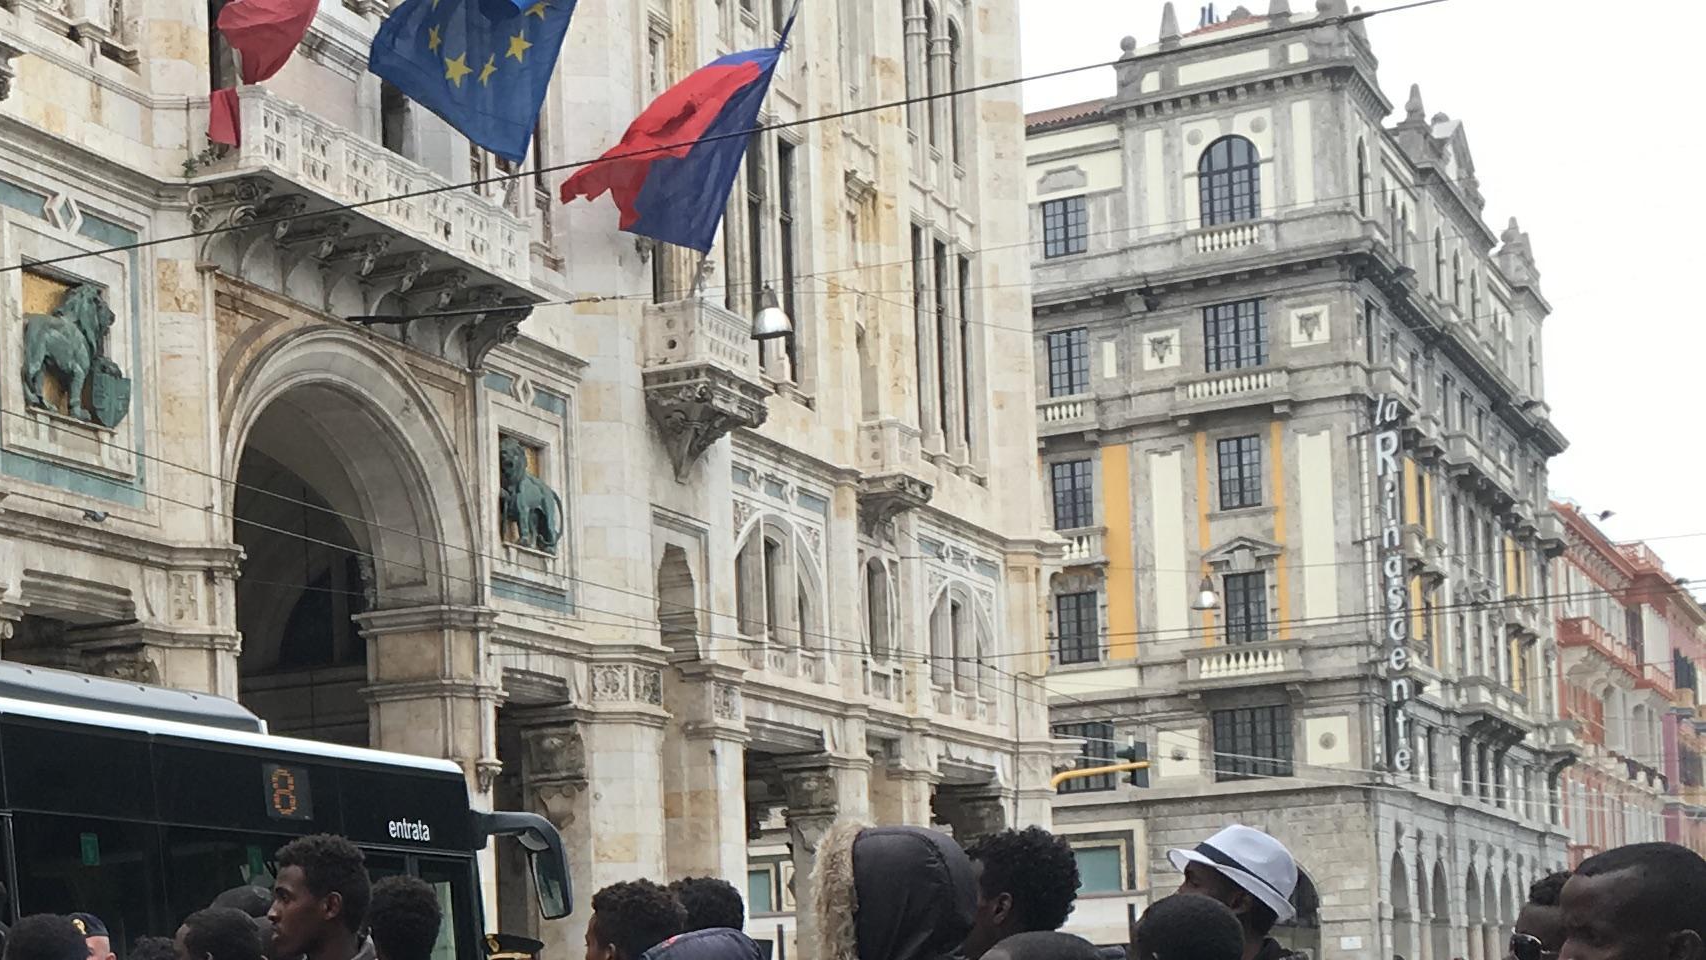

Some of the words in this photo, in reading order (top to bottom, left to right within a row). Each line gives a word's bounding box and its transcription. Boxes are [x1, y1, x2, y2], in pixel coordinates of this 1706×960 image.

[1375, 392, 1399, 425] la
[1375, 429, 1412, 771] Rinascente
[271, 767, 296, 816] 8
[388, 817, 431, 842] entrata
